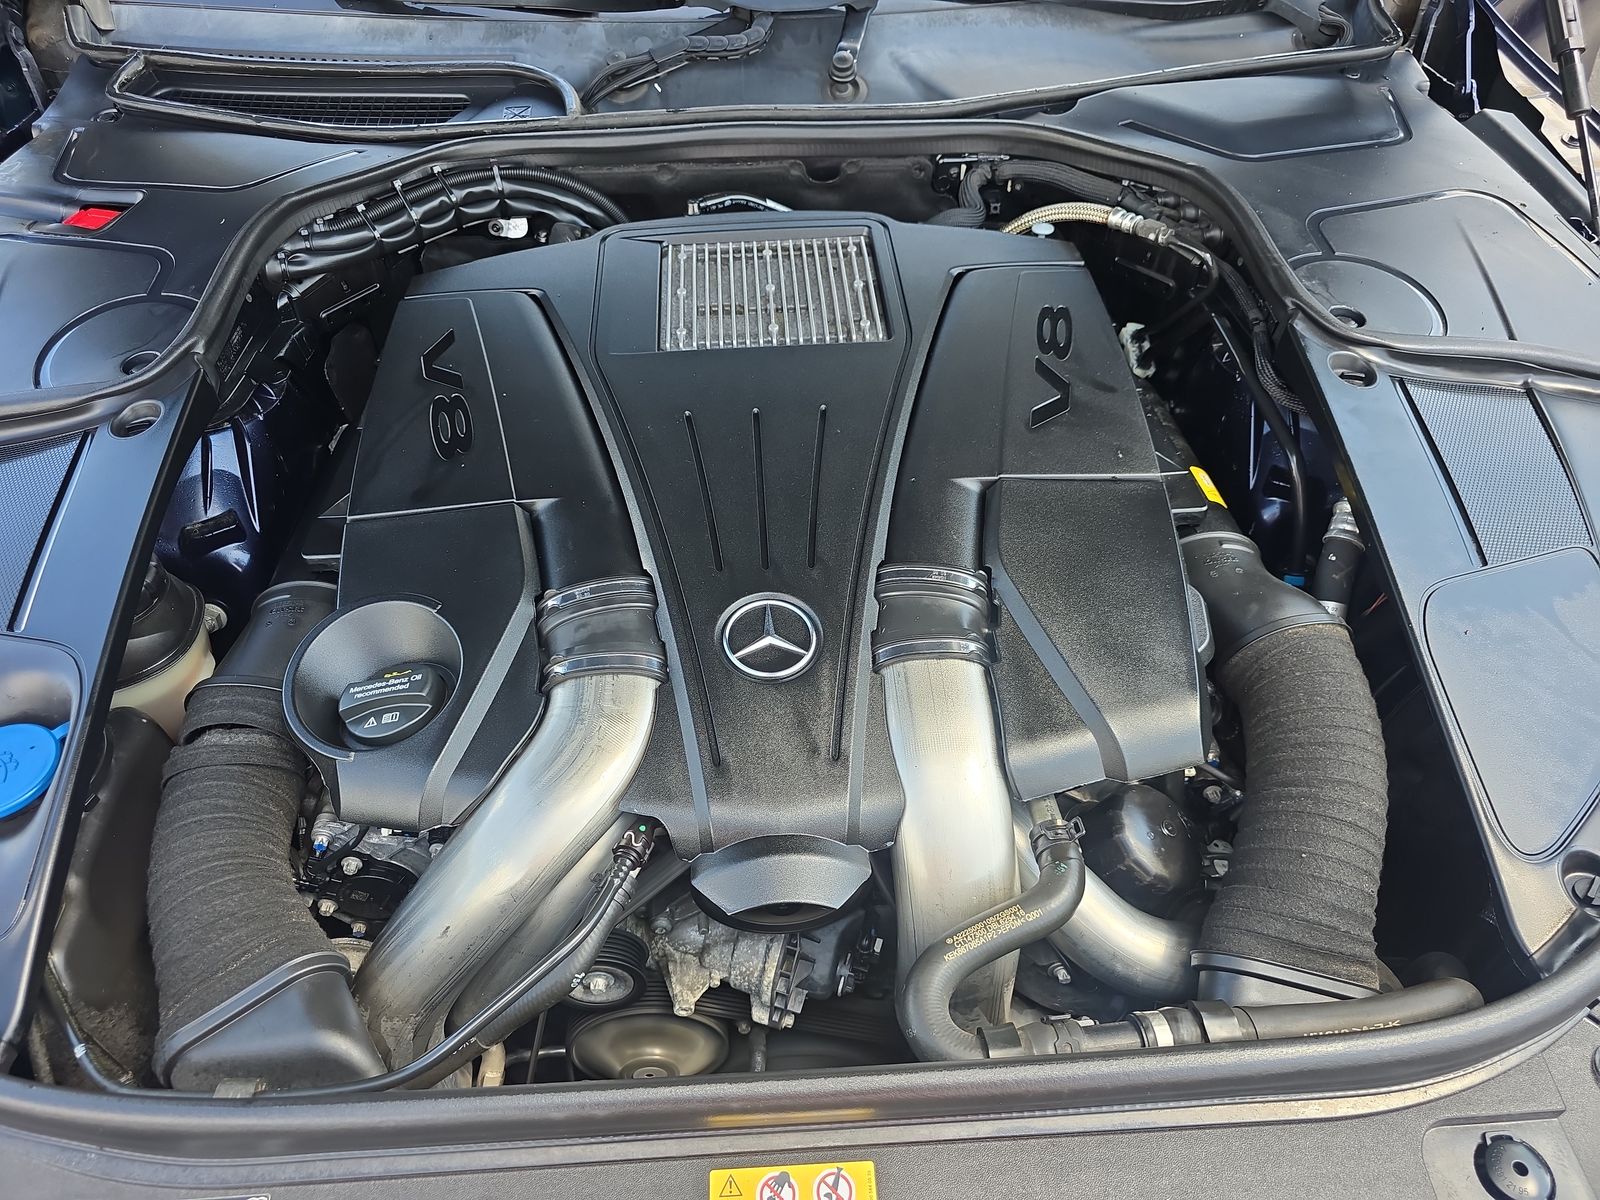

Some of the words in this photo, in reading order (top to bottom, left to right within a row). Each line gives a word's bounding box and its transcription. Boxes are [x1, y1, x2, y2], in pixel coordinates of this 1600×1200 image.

[420, 328, 475, 461] V8
[1029, 304, 1073, 429] V8
[349, 677, 409, 694] Mercedes-Benz
[410, 673, 423, 682] Oil
[354, 682, 410, 699] recommended
